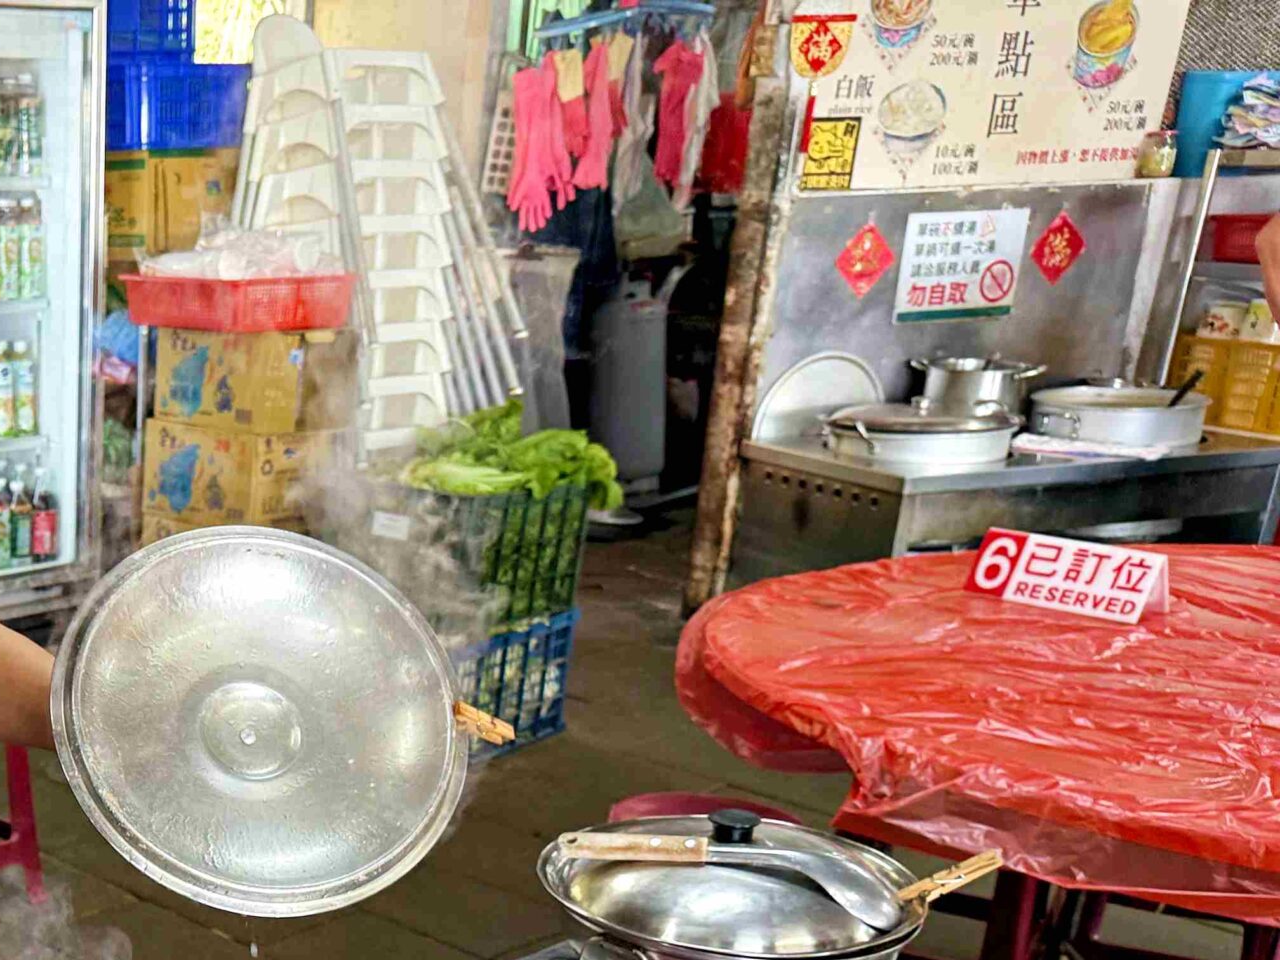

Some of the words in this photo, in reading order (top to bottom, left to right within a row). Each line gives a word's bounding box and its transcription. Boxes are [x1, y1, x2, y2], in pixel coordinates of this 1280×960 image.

[835, 74, 876, 99] 白飯
[906, 282, 969, 307] 勿自取
[974, 536, 1018, 591] 6
[1024, 542, 1153, 594] 已訂位
[1013, 581, 1137, 616] RESERVED
